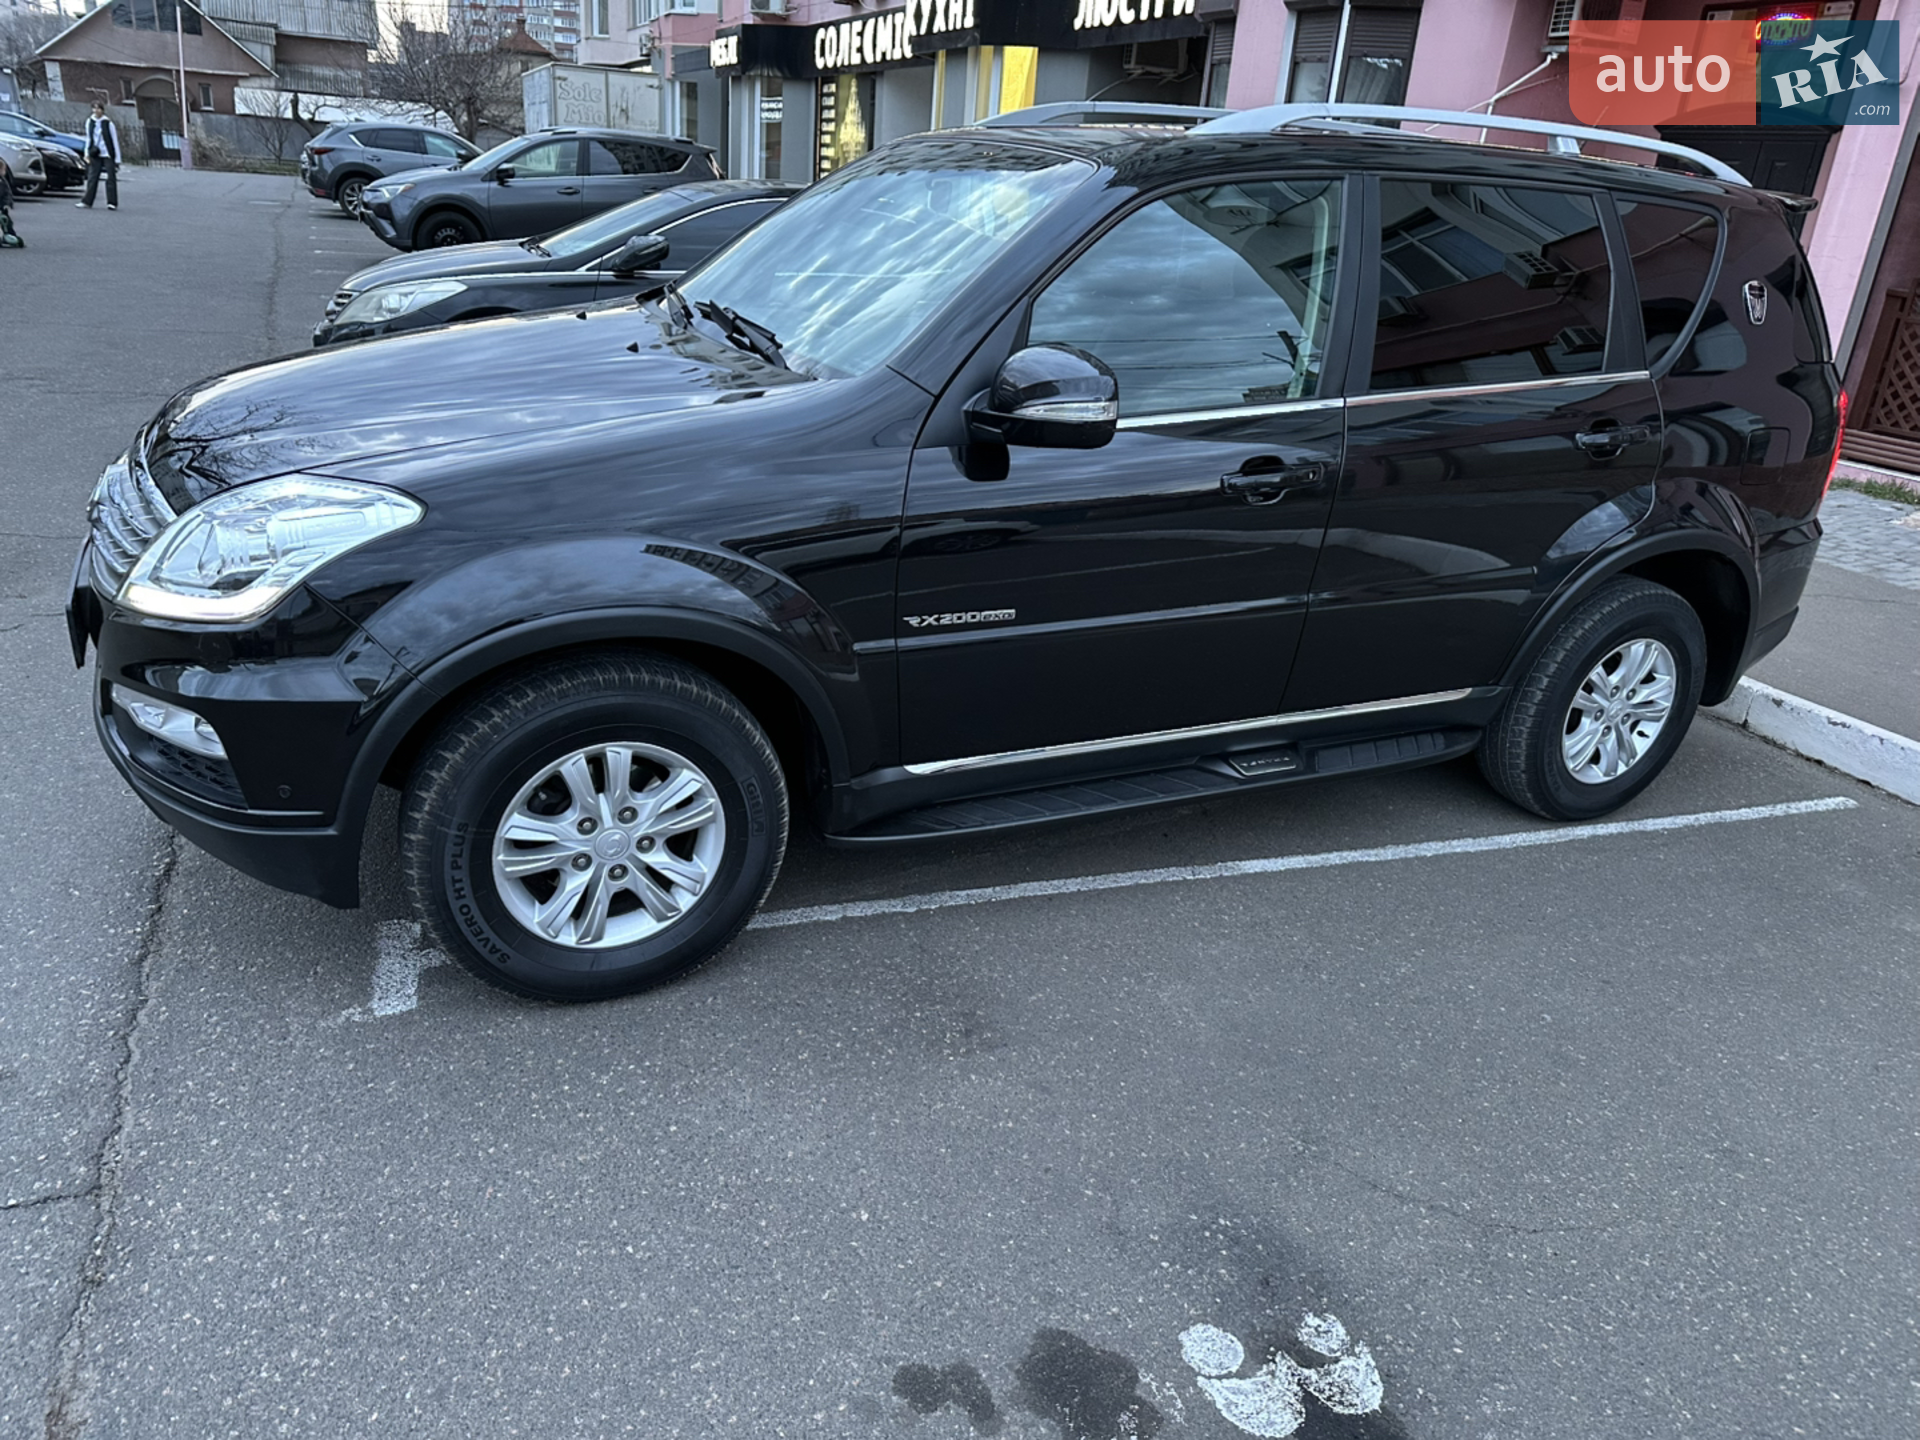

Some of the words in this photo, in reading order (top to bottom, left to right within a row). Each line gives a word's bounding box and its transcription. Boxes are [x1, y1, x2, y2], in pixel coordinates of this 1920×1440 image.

[559, 81, 602, 103] Sole
[564, 103, 606, 124] Mio
[451, 821, 470, 871] PLUS
[451, 875, 467, 900] HT
[458, 903, 511, 965] SAVERO
